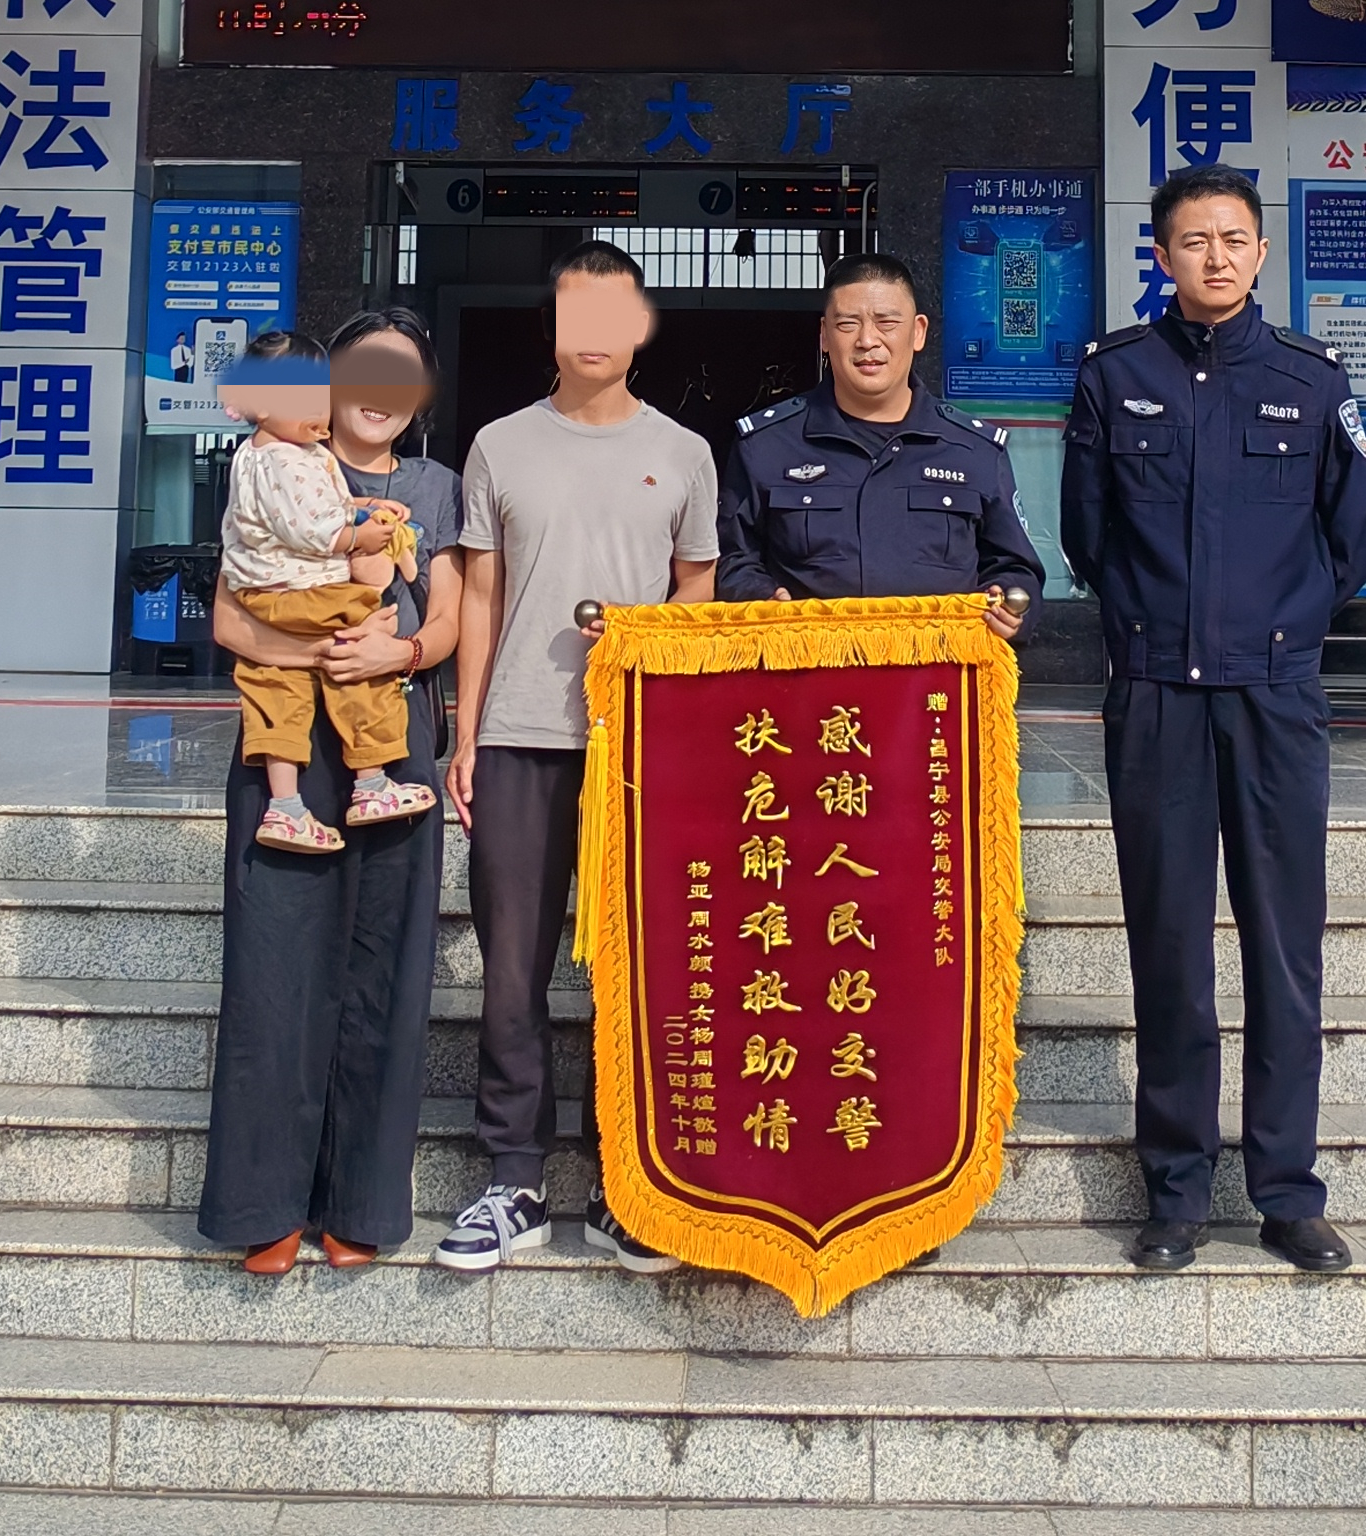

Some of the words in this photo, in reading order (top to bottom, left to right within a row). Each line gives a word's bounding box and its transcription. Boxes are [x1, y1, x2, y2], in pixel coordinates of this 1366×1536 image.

[391, 79, 852, 156] 服务大厅
[456, 184, 470, 206] 6
[709, 187, 721, 210] 7
[954, 178, 1083, 198] 一部手机办事通
[166, 239, 283, 256] 支付宝市民中心
[1261, 404, 1300, 419] XG1078
[734, 709, 801, 1155] 扶危解难救助情
[814, 704, 883, 1153] 感谢人民好交警
